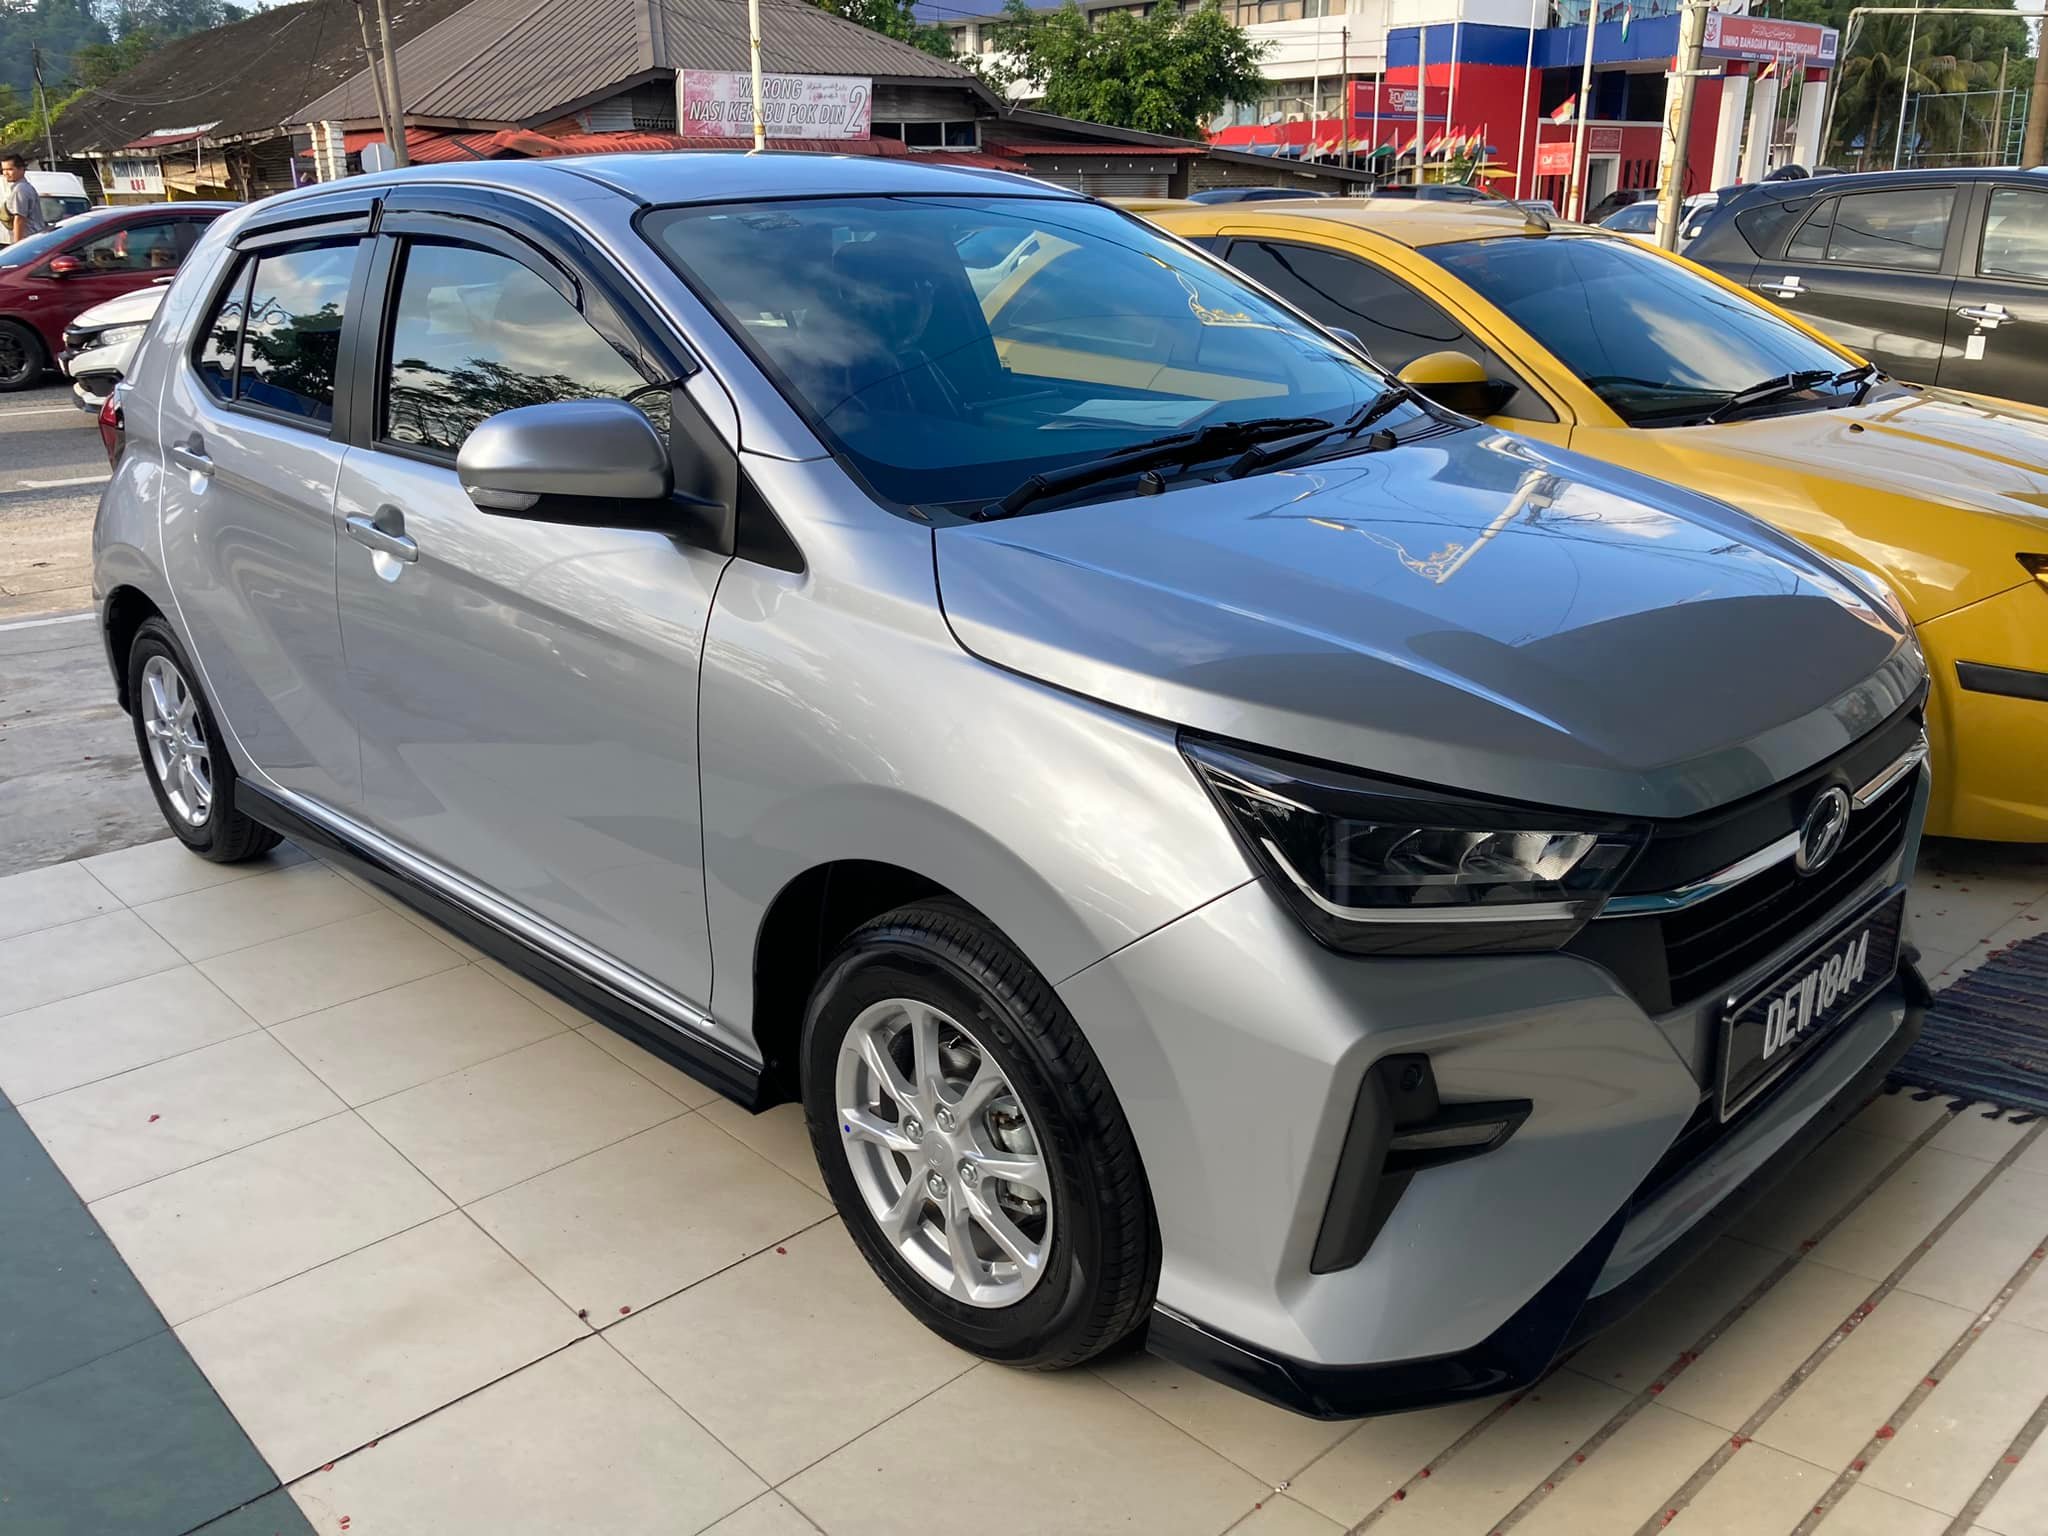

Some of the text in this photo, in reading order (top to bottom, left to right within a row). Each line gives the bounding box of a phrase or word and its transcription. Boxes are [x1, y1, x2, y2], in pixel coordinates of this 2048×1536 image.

[738, 76, 802, 100] WRONG
[689, 101, 847, 125] NASI KERBU POK DIN
[844, 85, 867, 133] 2
